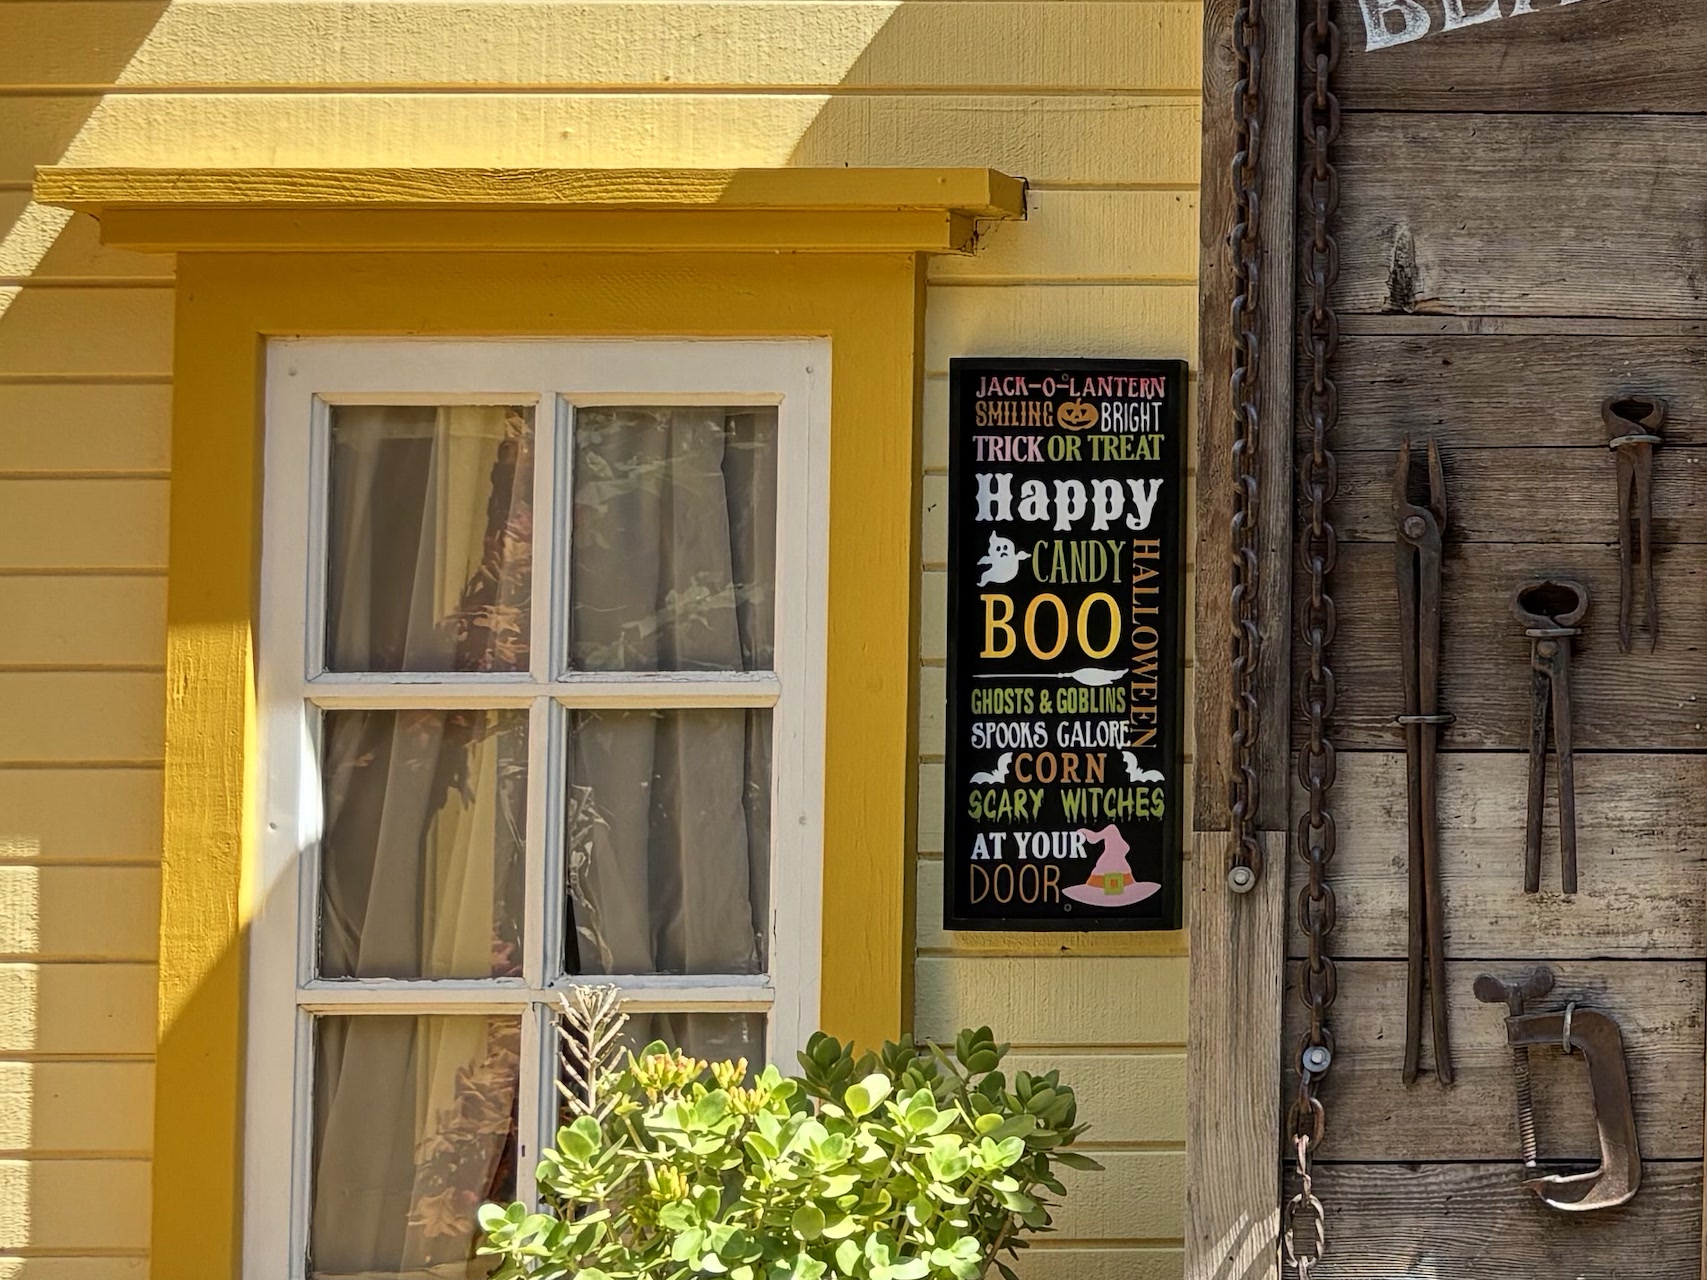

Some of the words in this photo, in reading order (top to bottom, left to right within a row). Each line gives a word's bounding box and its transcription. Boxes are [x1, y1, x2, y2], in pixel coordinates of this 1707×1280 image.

[976, 376, 1166, 399] JACK-O-LANTERN
[975, 401, 1054, 427] SMILING
[1101, 402, 1162, 433] BRIGHT
[973, 435, 1044, 462] TRICK
[1047, 435, 1082, 462] OR
[1088, 434, 1165, 461] TREAT
[975, 473, 1164, 531] Happy
[1032, 540, 1126, 584] CANDY
[980, 592, 1122, 660] BOO
[1131, 538, 1160, 748] HALLOWEEN
[971, 688, 1034, 714] GHOSTS
[1039, 689, 1053, 714] &
[1056, 687, 1126, 713] GOBLINS
[971, 721, 1048, 749] SPOOKS
[1057, 721, 1132, 749] GALORE
[1015, 752, 1107, 784] CORN
[968, 788, 1044, 823] SCARY
[1061, 787, 1165, 823] WITCHES
[970, 832, 1007, 860] AT
[1013, 831, 1087, 859] YOUR
[970, 864, 1060, 904] DOOR
